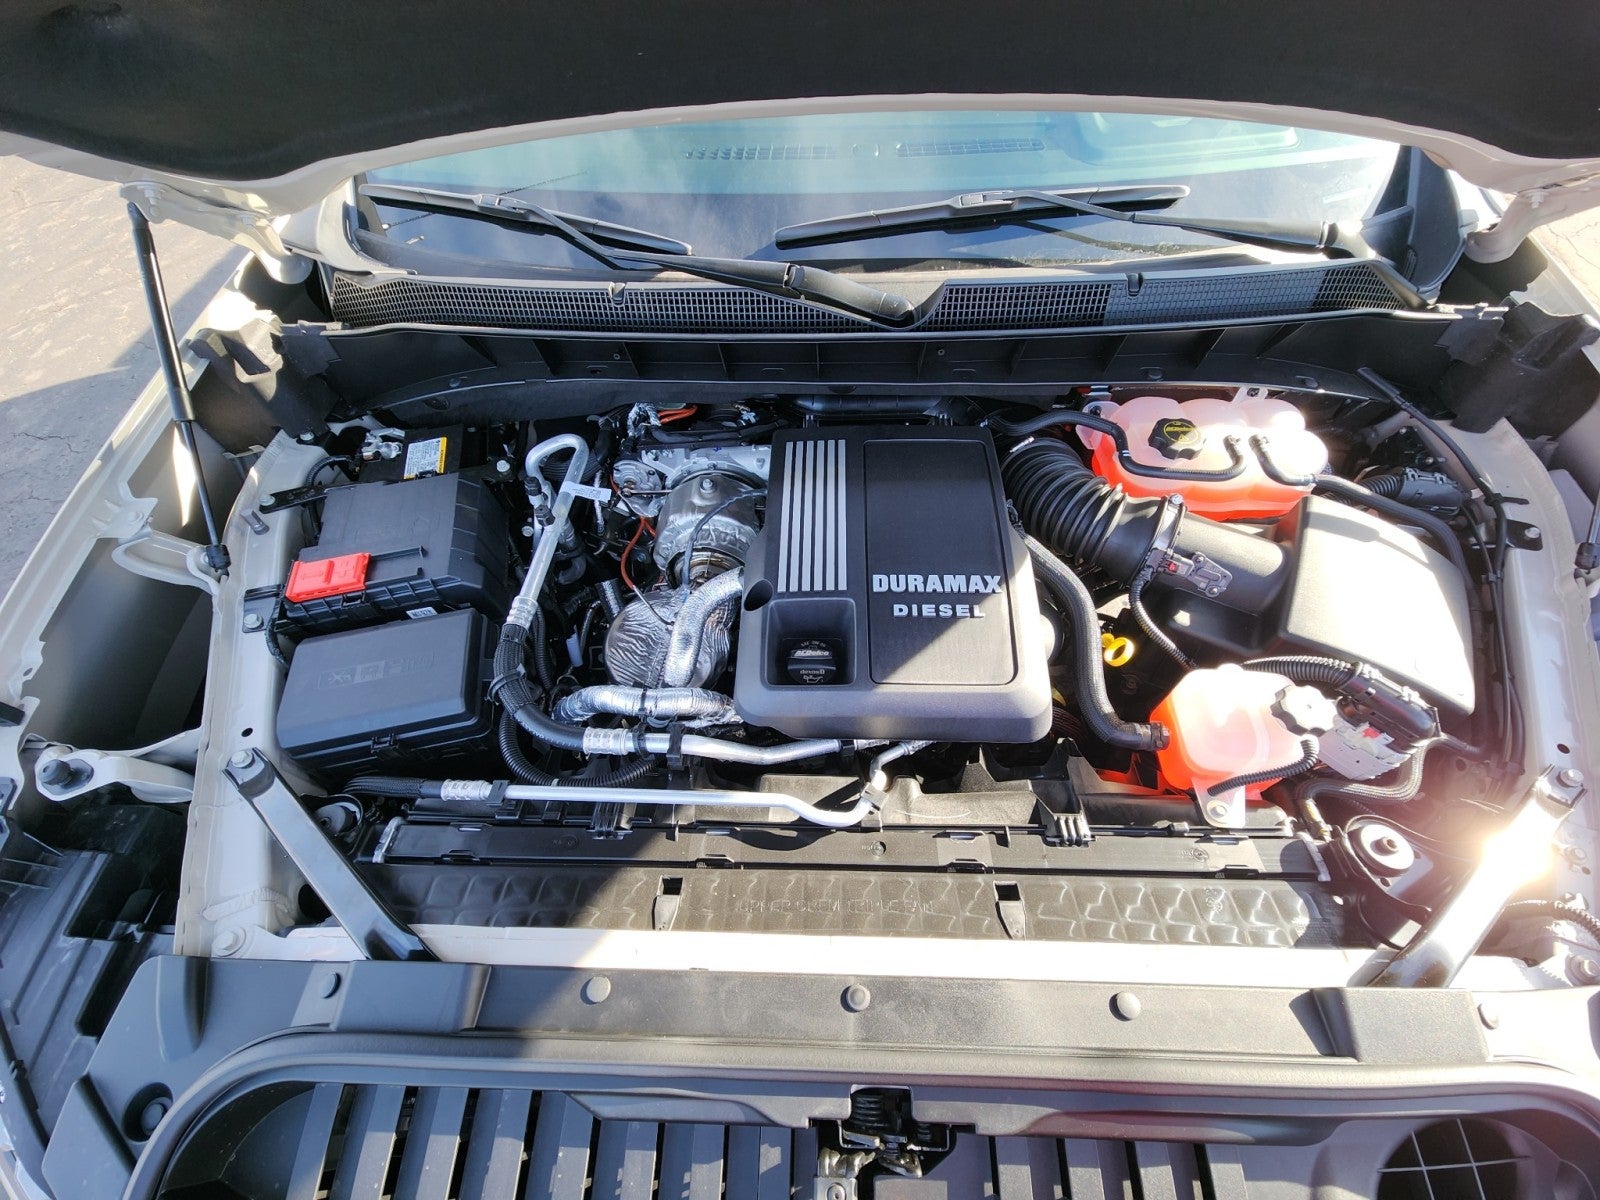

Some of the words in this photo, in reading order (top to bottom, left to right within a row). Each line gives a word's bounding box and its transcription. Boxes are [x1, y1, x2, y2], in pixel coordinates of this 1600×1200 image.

[872, 574, 1002, 593] DURAMAX
[893, 603, 986, 618] DIESEL
[794, 649, 830, 657] ACDelco
